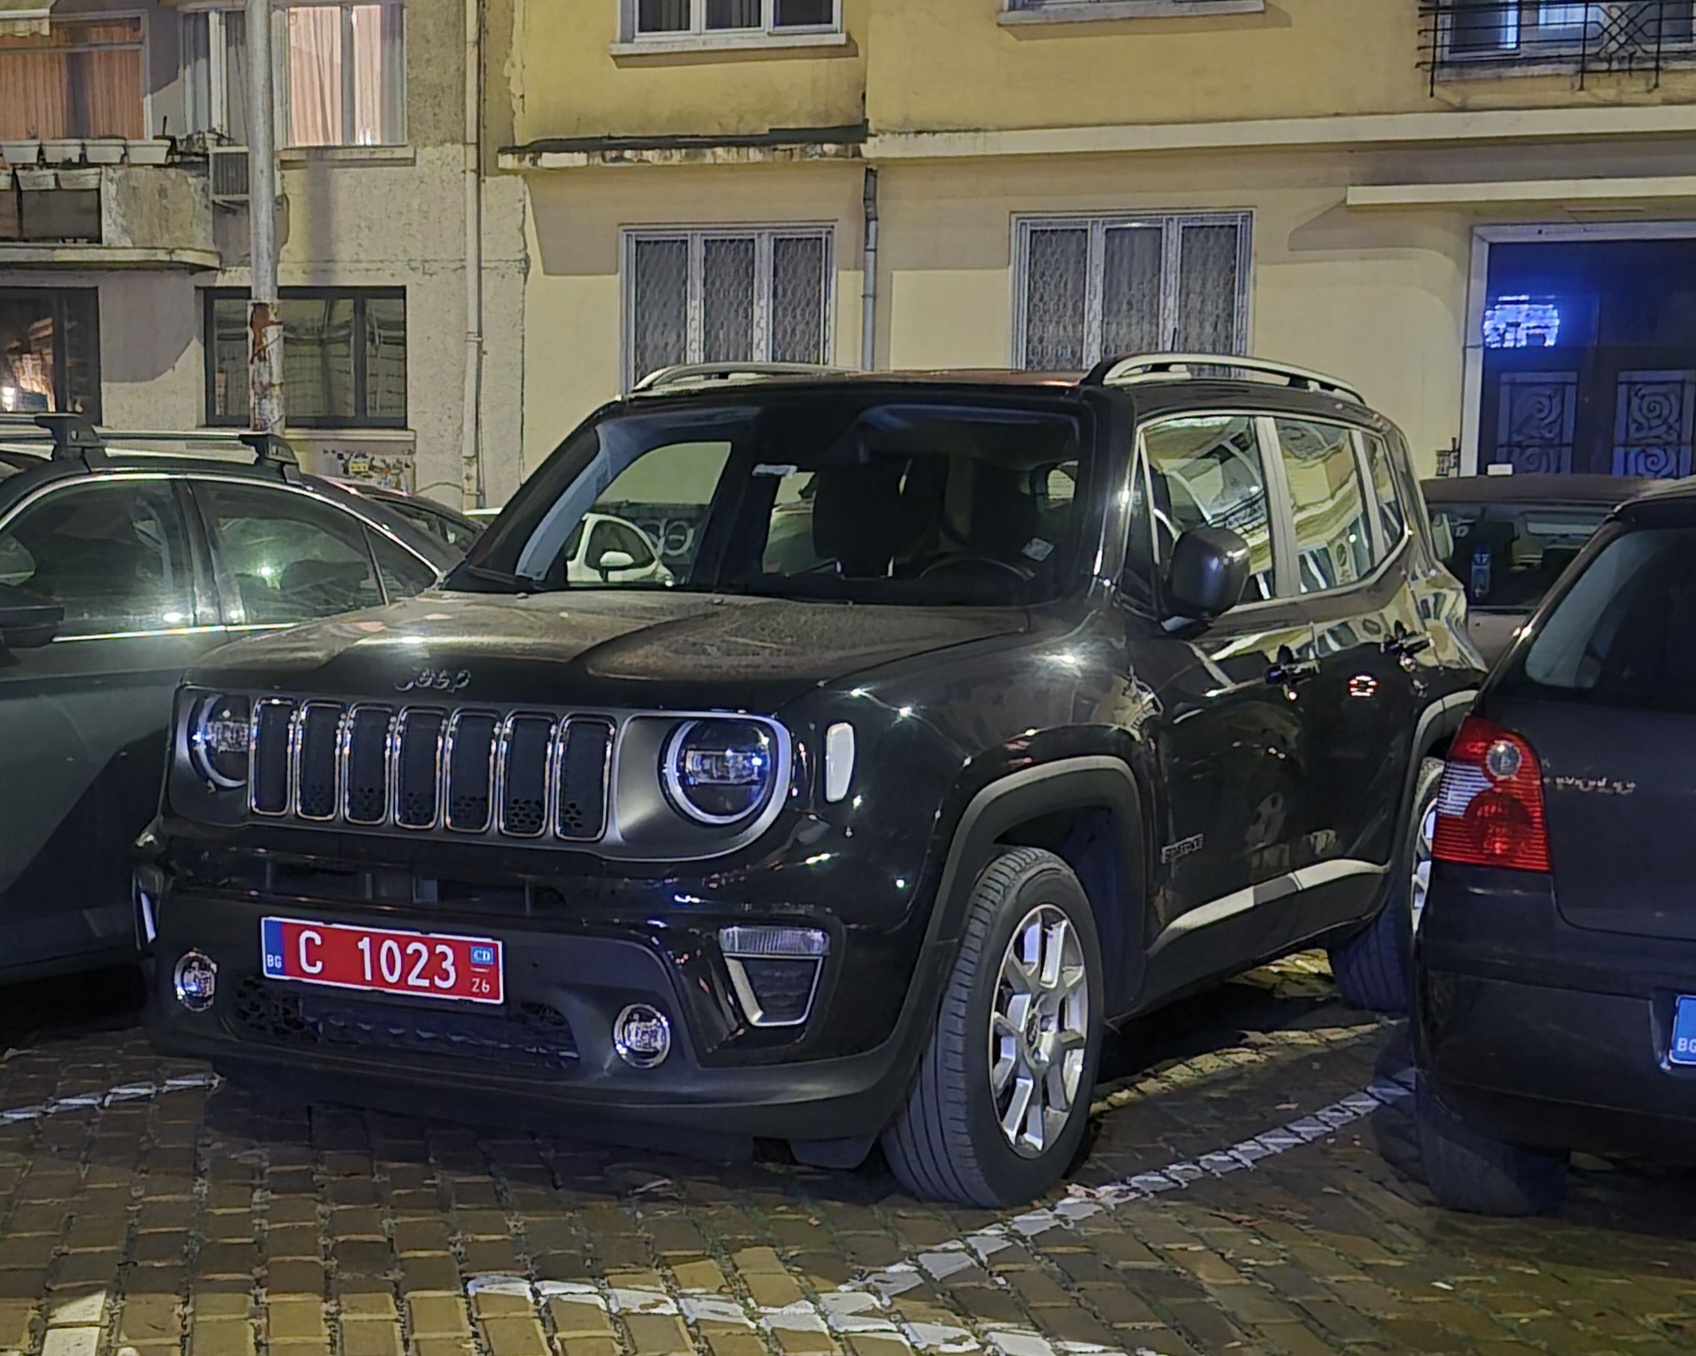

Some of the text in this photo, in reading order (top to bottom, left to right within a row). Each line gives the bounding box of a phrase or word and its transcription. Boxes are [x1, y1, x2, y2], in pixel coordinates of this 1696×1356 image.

[267, 954, 282, 969] BG
[299, 929, 456, 989] C 1023
[473, 949, 491, 962] CD
[471, 978, 490, 993] 26
[1677, 1037, 1696, 1053] BG
